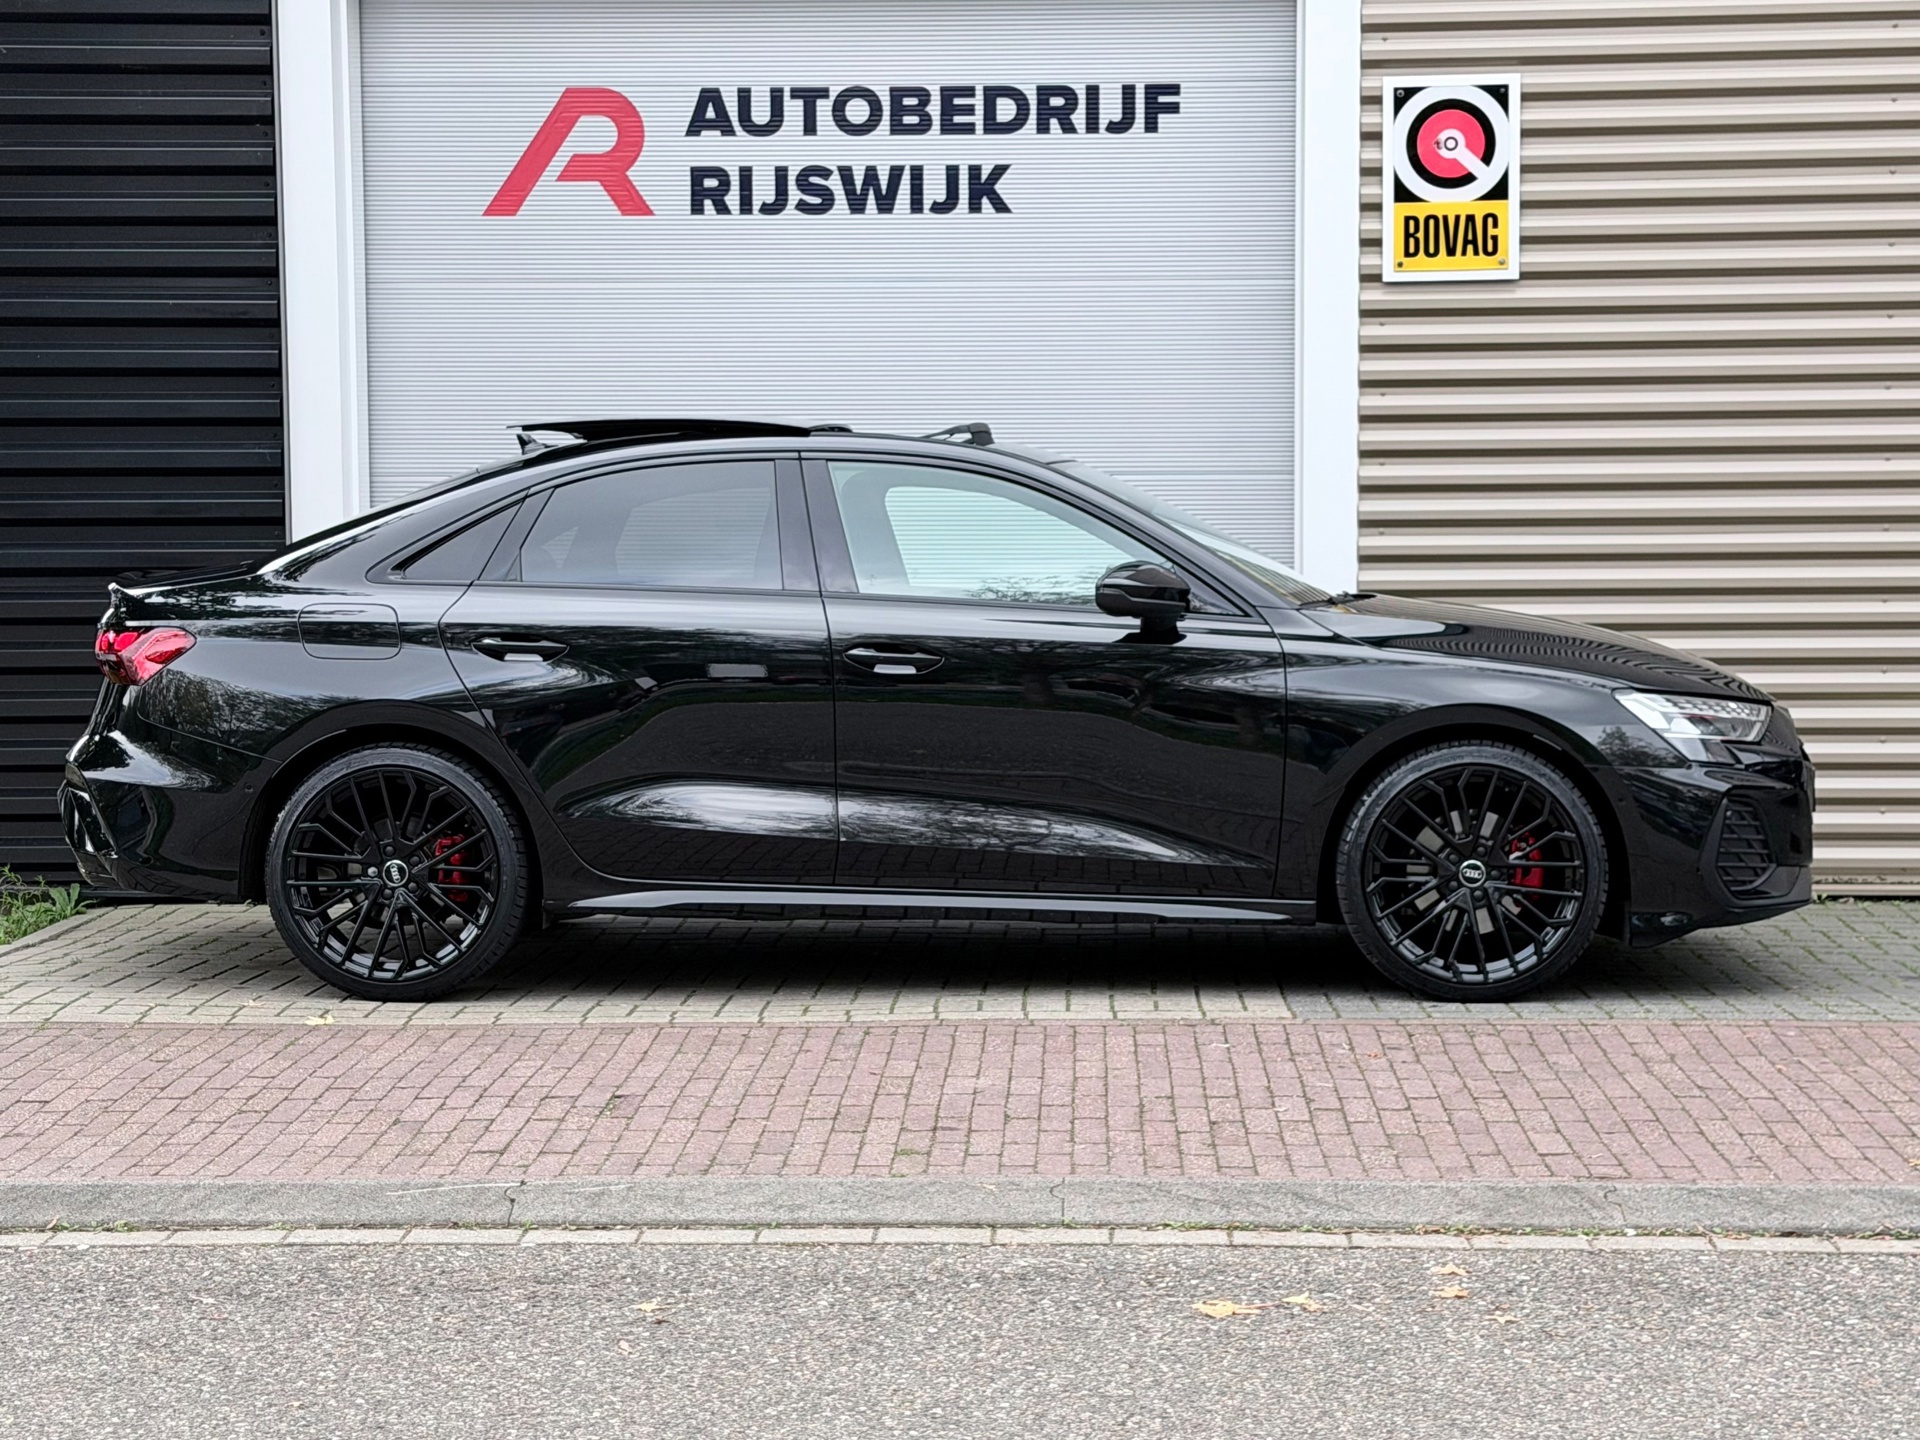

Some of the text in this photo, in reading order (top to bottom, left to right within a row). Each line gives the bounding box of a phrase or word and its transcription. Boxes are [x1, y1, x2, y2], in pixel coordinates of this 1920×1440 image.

[685, 83, 1181, 137] AUTOBEDRIJF
[689, 164, 1012, 216] RIJSWIJK
[1403, 212, 1499, 258] BOVAG
